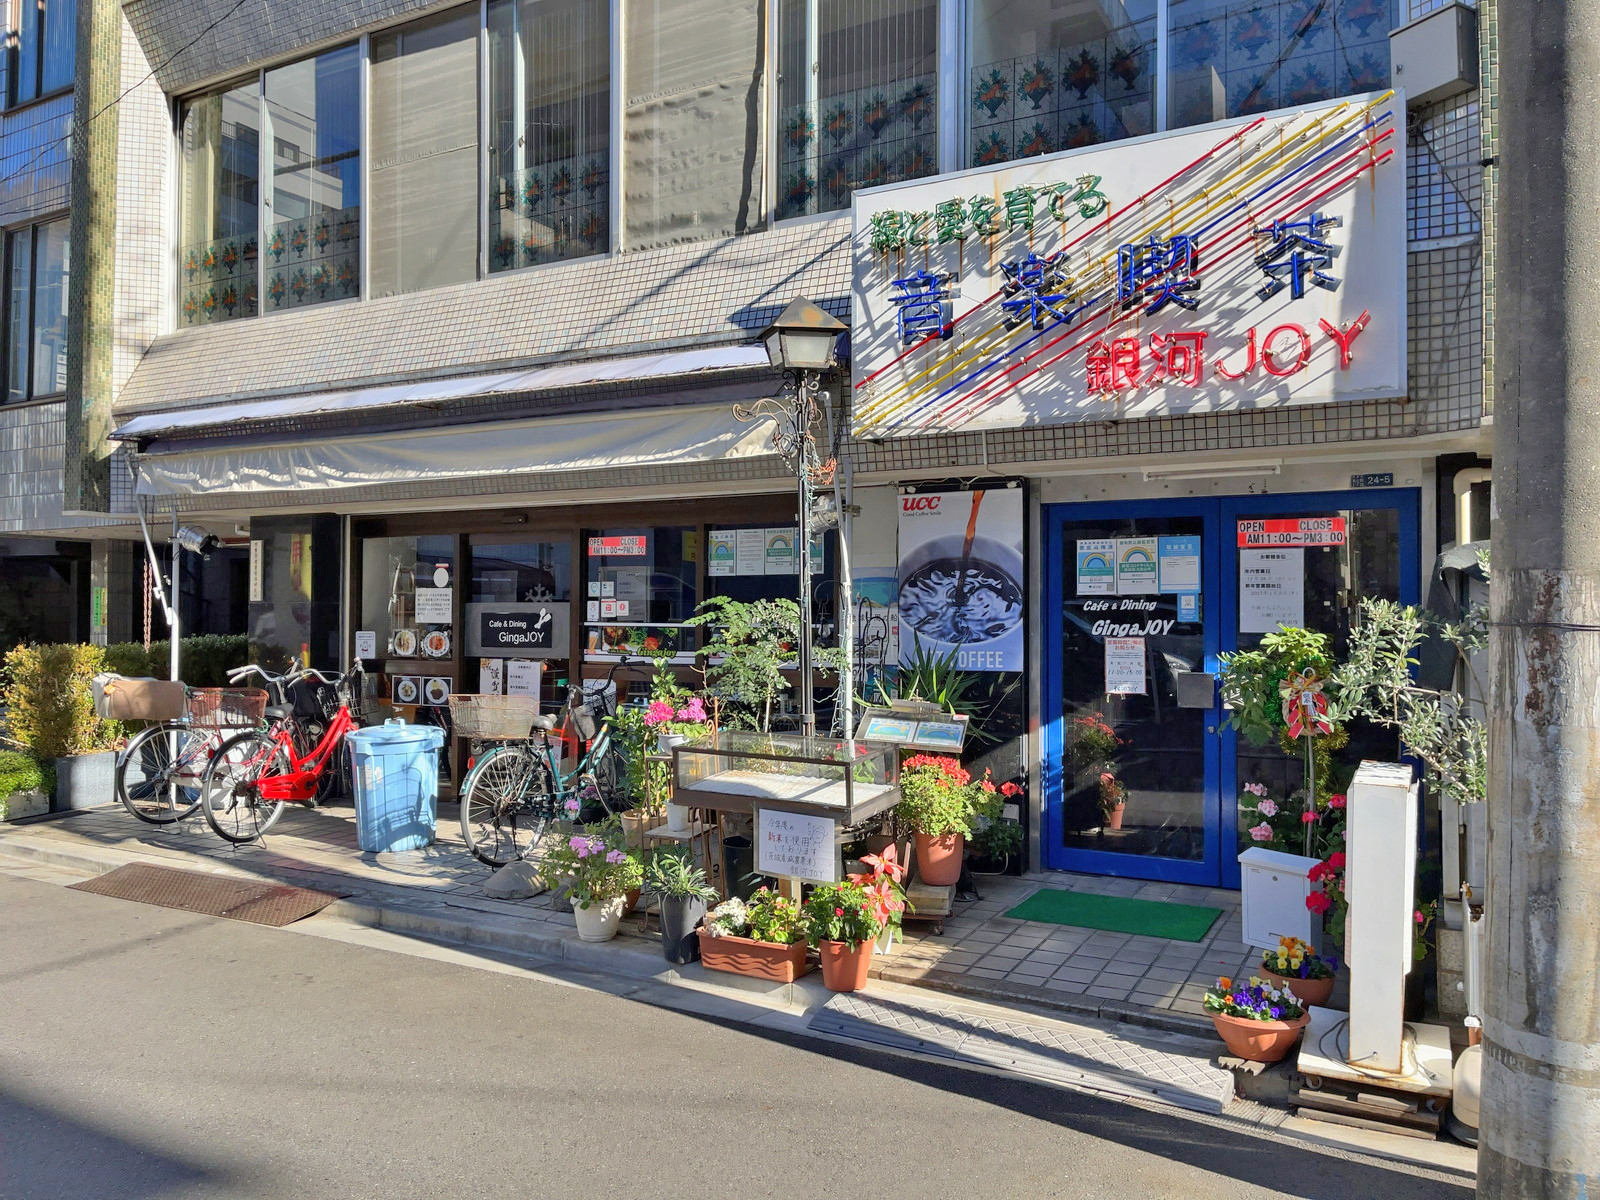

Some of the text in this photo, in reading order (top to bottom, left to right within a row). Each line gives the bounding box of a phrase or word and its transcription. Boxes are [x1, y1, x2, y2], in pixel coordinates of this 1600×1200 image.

[888, 211, 1343, 346] 音楽喫茶
[1367, 475, 1391, 485] 24-5
[1239, 520, 1332, 532] OPEN CLOSE
[620, 537, 638, 545] CLOSE
[1083, 600, 1108, 612] Cafe
[1120, 599, 1157, 611] Dining
[508, 620, 527, 629] Dining
[1091, 619, 1175, 637] GingaJOY
[498, 631, 545, 645] GingaJOY
[767, 817, 795, 831] 今年度の
[767, 831, 810, 848] 新米を使用
[774, 844, 817, 856] しております
